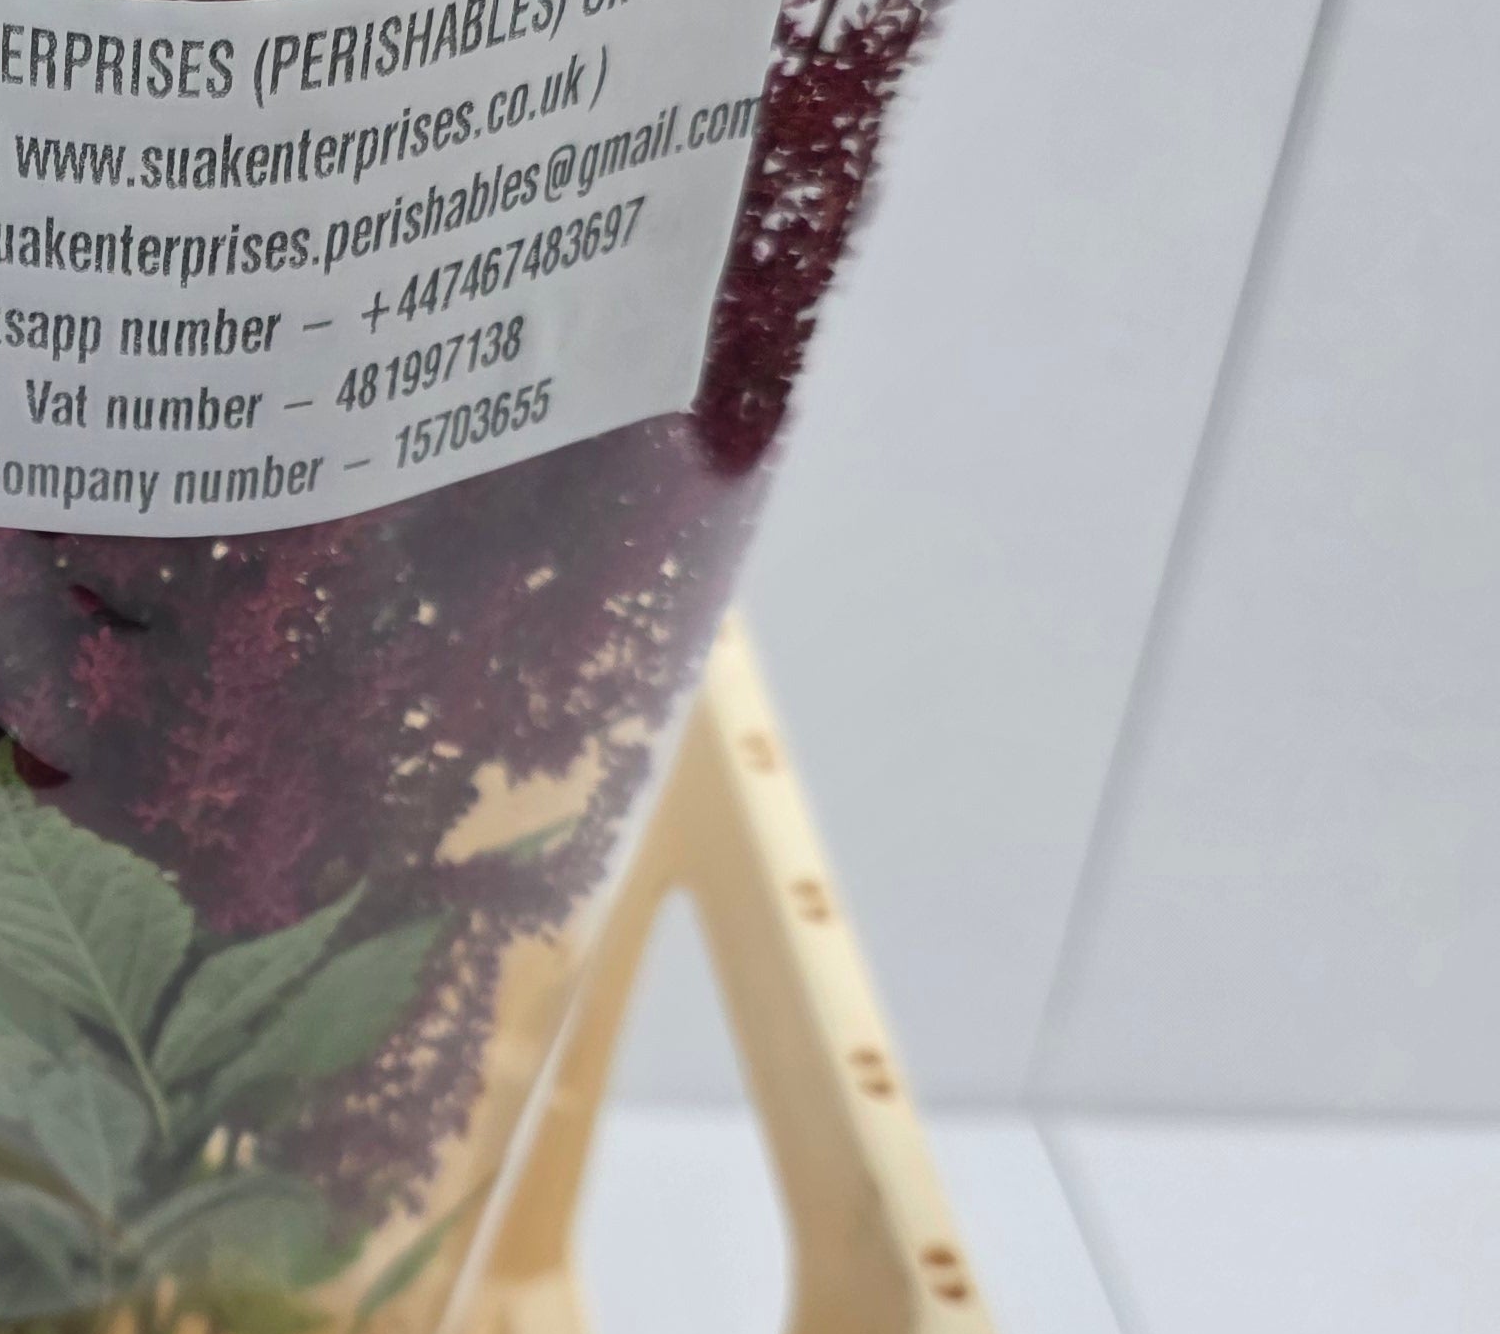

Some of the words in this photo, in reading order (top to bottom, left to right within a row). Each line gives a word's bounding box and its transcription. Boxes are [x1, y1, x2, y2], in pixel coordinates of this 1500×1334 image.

[118, 307, 283, 357] number
[360, 196, 646, 334] +447467483697
[25, 378, 88, 429] Vat
[105, 386, 263, 432] number
[335, 315, 526, 413] 481997138
[173, 454, 324, 506] number
[394, 377, 553, 469] 15703655
